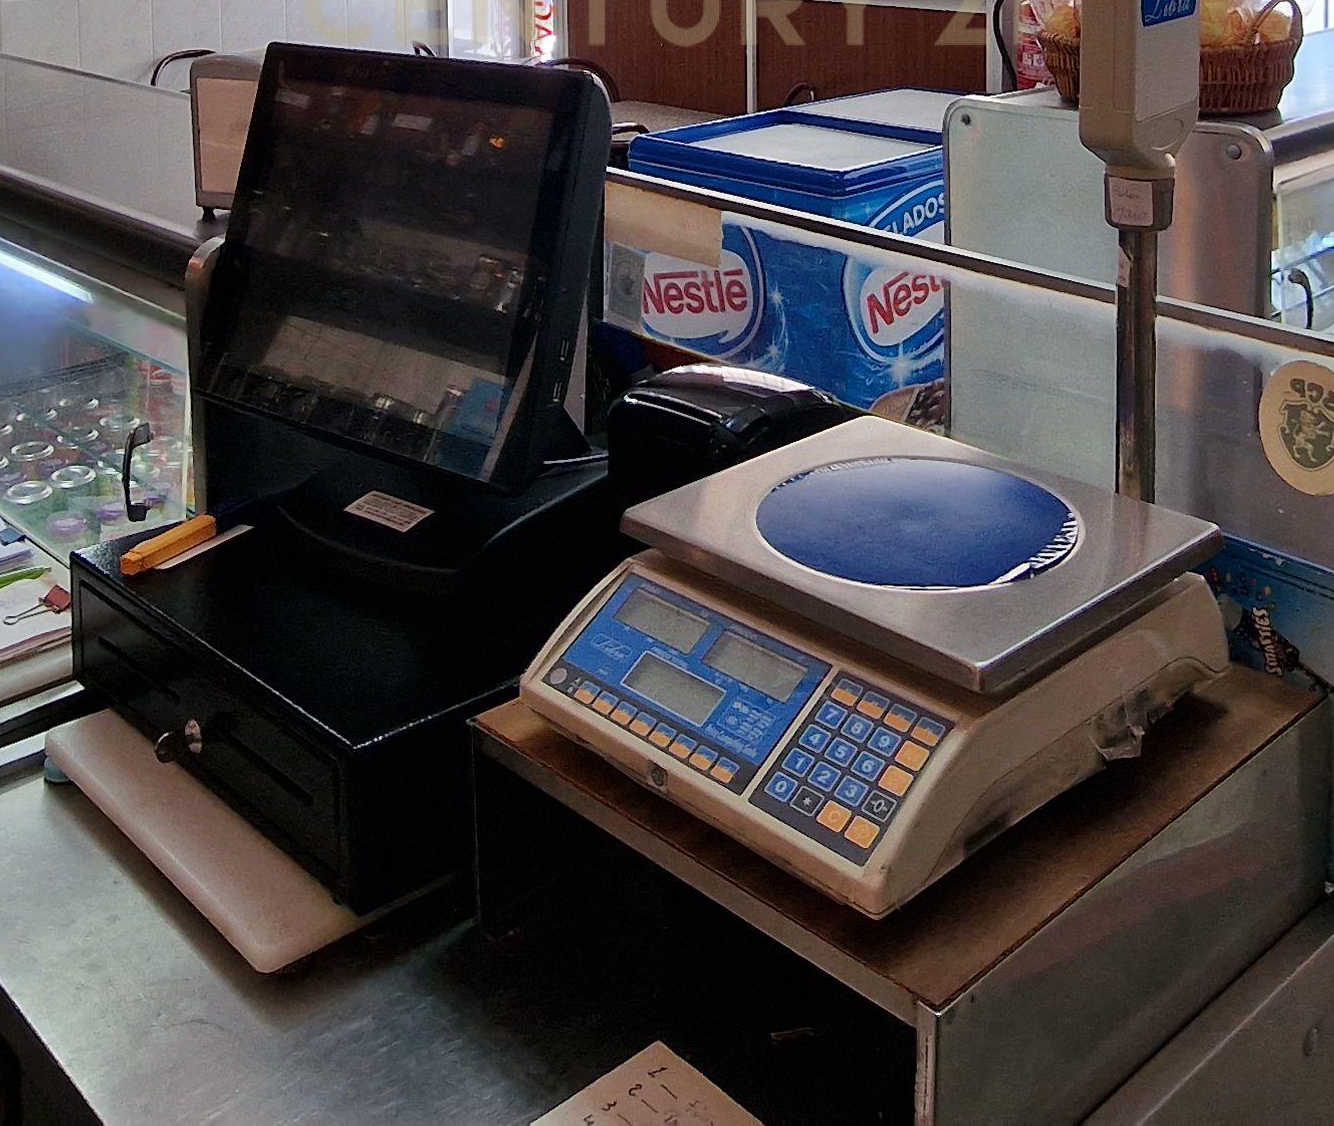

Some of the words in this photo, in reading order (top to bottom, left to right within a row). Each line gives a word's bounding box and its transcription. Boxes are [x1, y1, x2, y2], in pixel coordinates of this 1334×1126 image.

[643, 268, 748, 315] Nestlé
[825, 708, 839, 721] 7
[850, 721, 864, 735] 8
[879, 734, 892, 748] 9
[808, 733, 821, 746] 4
[835, 745, 847, 759] 5
[862, 759, 876, 773] 6
[774, 780, 787, 793] 0
[817, 770, 831, 784] 2
[845, 784, 859, 798] 3
[628, 1083, 643, 1097] 2
[601, 1100, 618, 1112] 3
